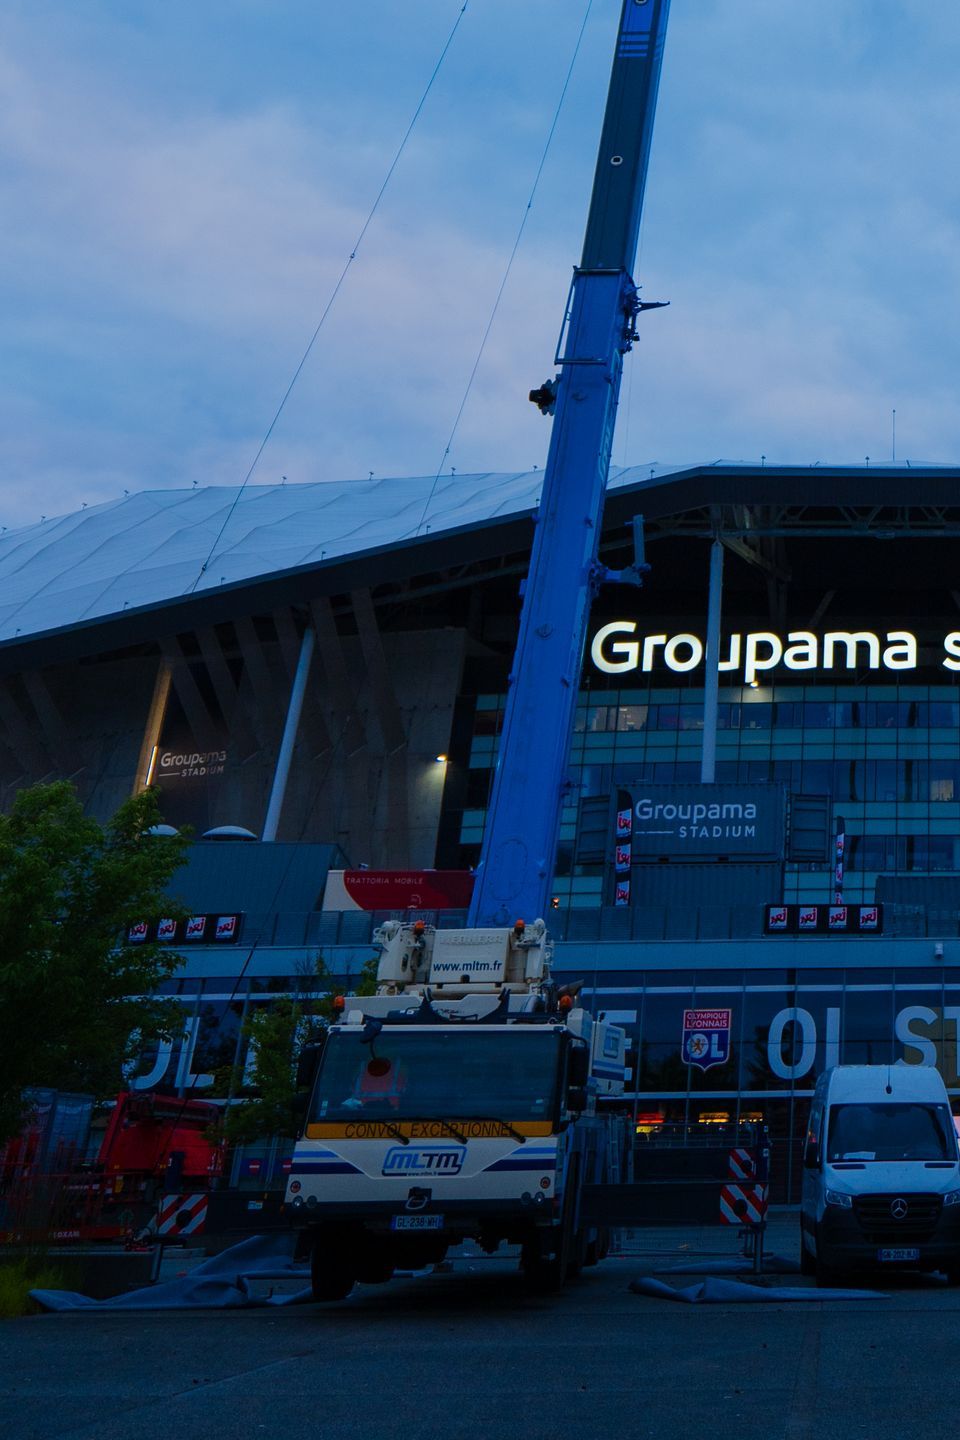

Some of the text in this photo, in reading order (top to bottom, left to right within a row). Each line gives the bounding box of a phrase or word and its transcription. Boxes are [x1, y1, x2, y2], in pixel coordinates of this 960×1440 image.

[591, 621, 918, 683] Groupama
[635, 799, 757, 824] Groupama
[679, 826, 756, 838] STADIUM
[394, 877, 424, 885] MOBILE
[433, 961, 502, 971] www.mltm.fr
[686, 1012, 728, 1020] OLYMPIQUE
[686, 1020, 728, 1028] LYONNAIS
